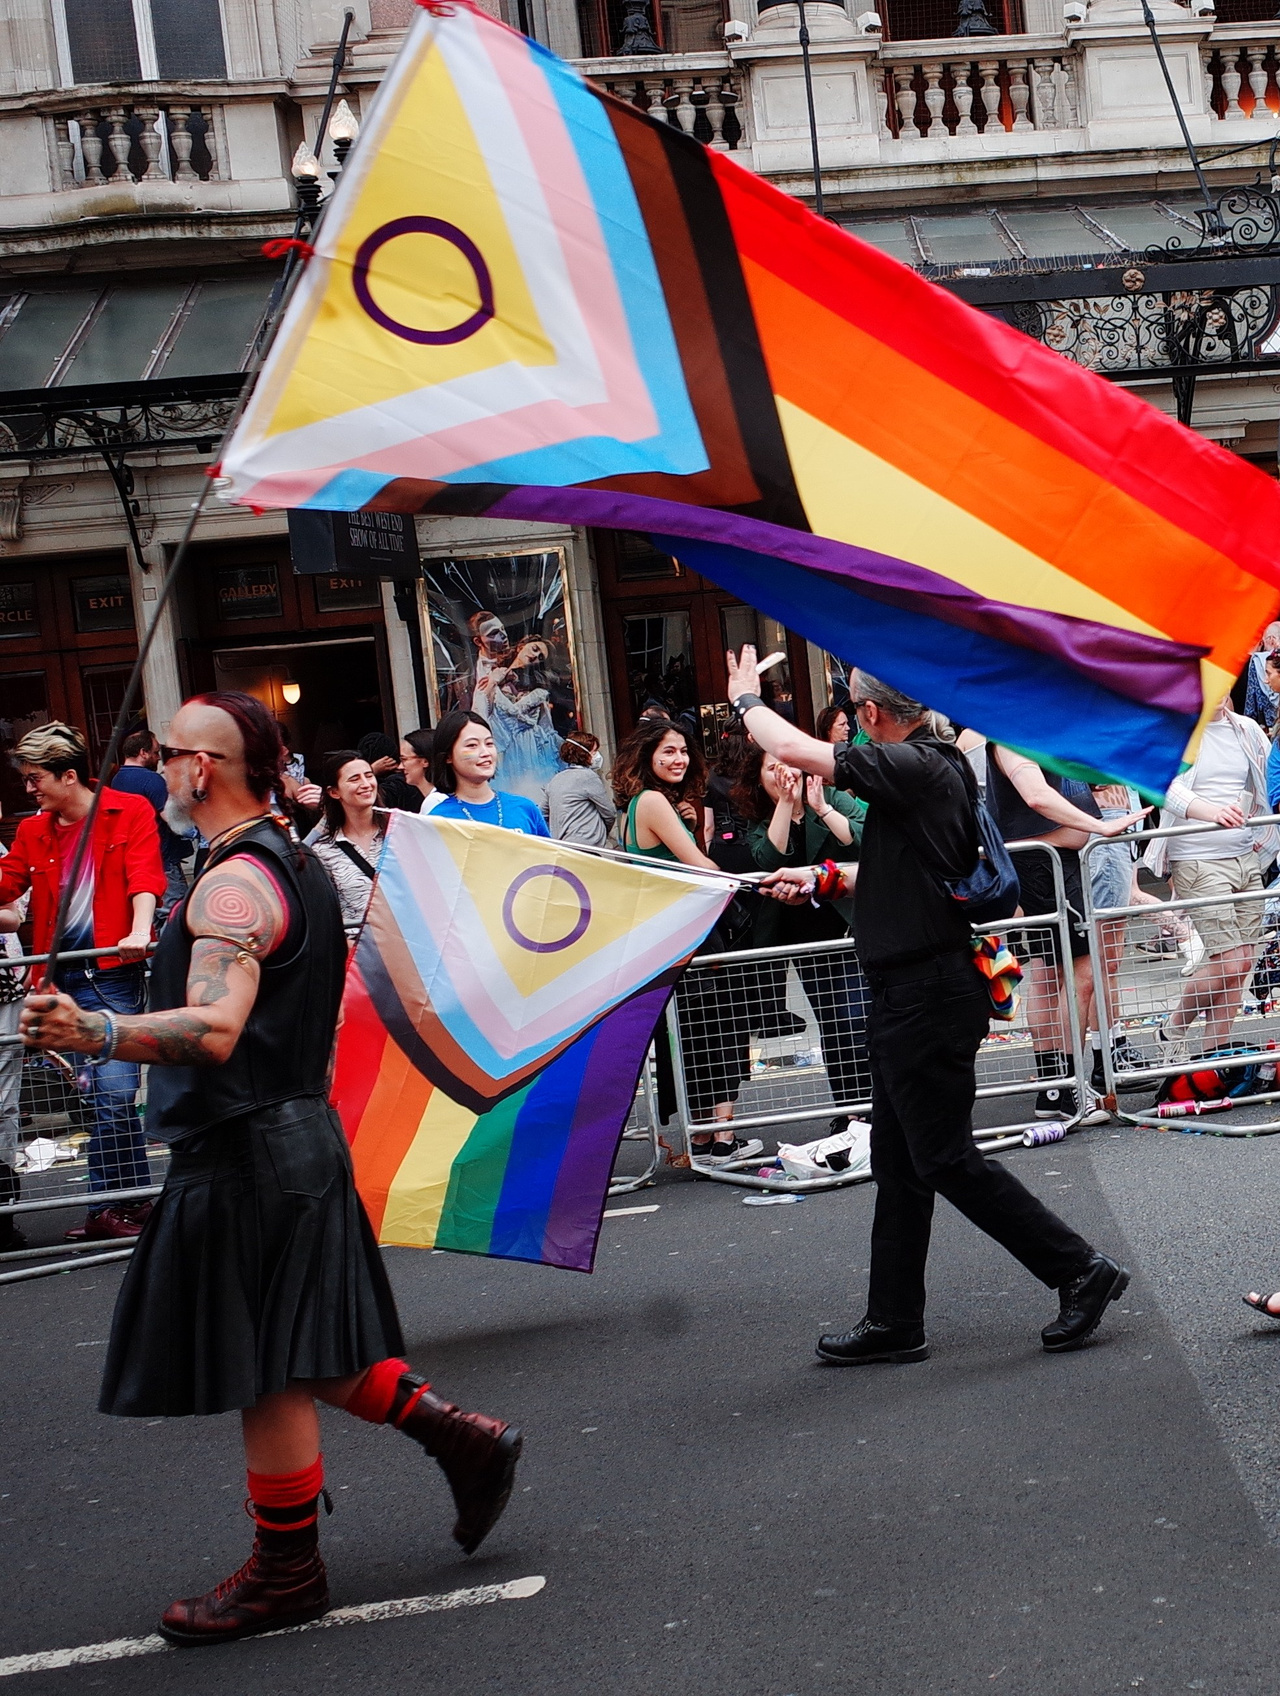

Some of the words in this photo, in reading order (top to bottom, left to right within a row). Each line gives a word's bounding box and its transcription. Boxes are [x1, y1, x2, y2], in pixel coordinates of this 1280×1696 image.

[368, 530, 378, 549] OF
[378, 532, 390, 551] ALL
[220, 583, 277, 598] GALLERY
[89, 596, 124, 609] EXIT
